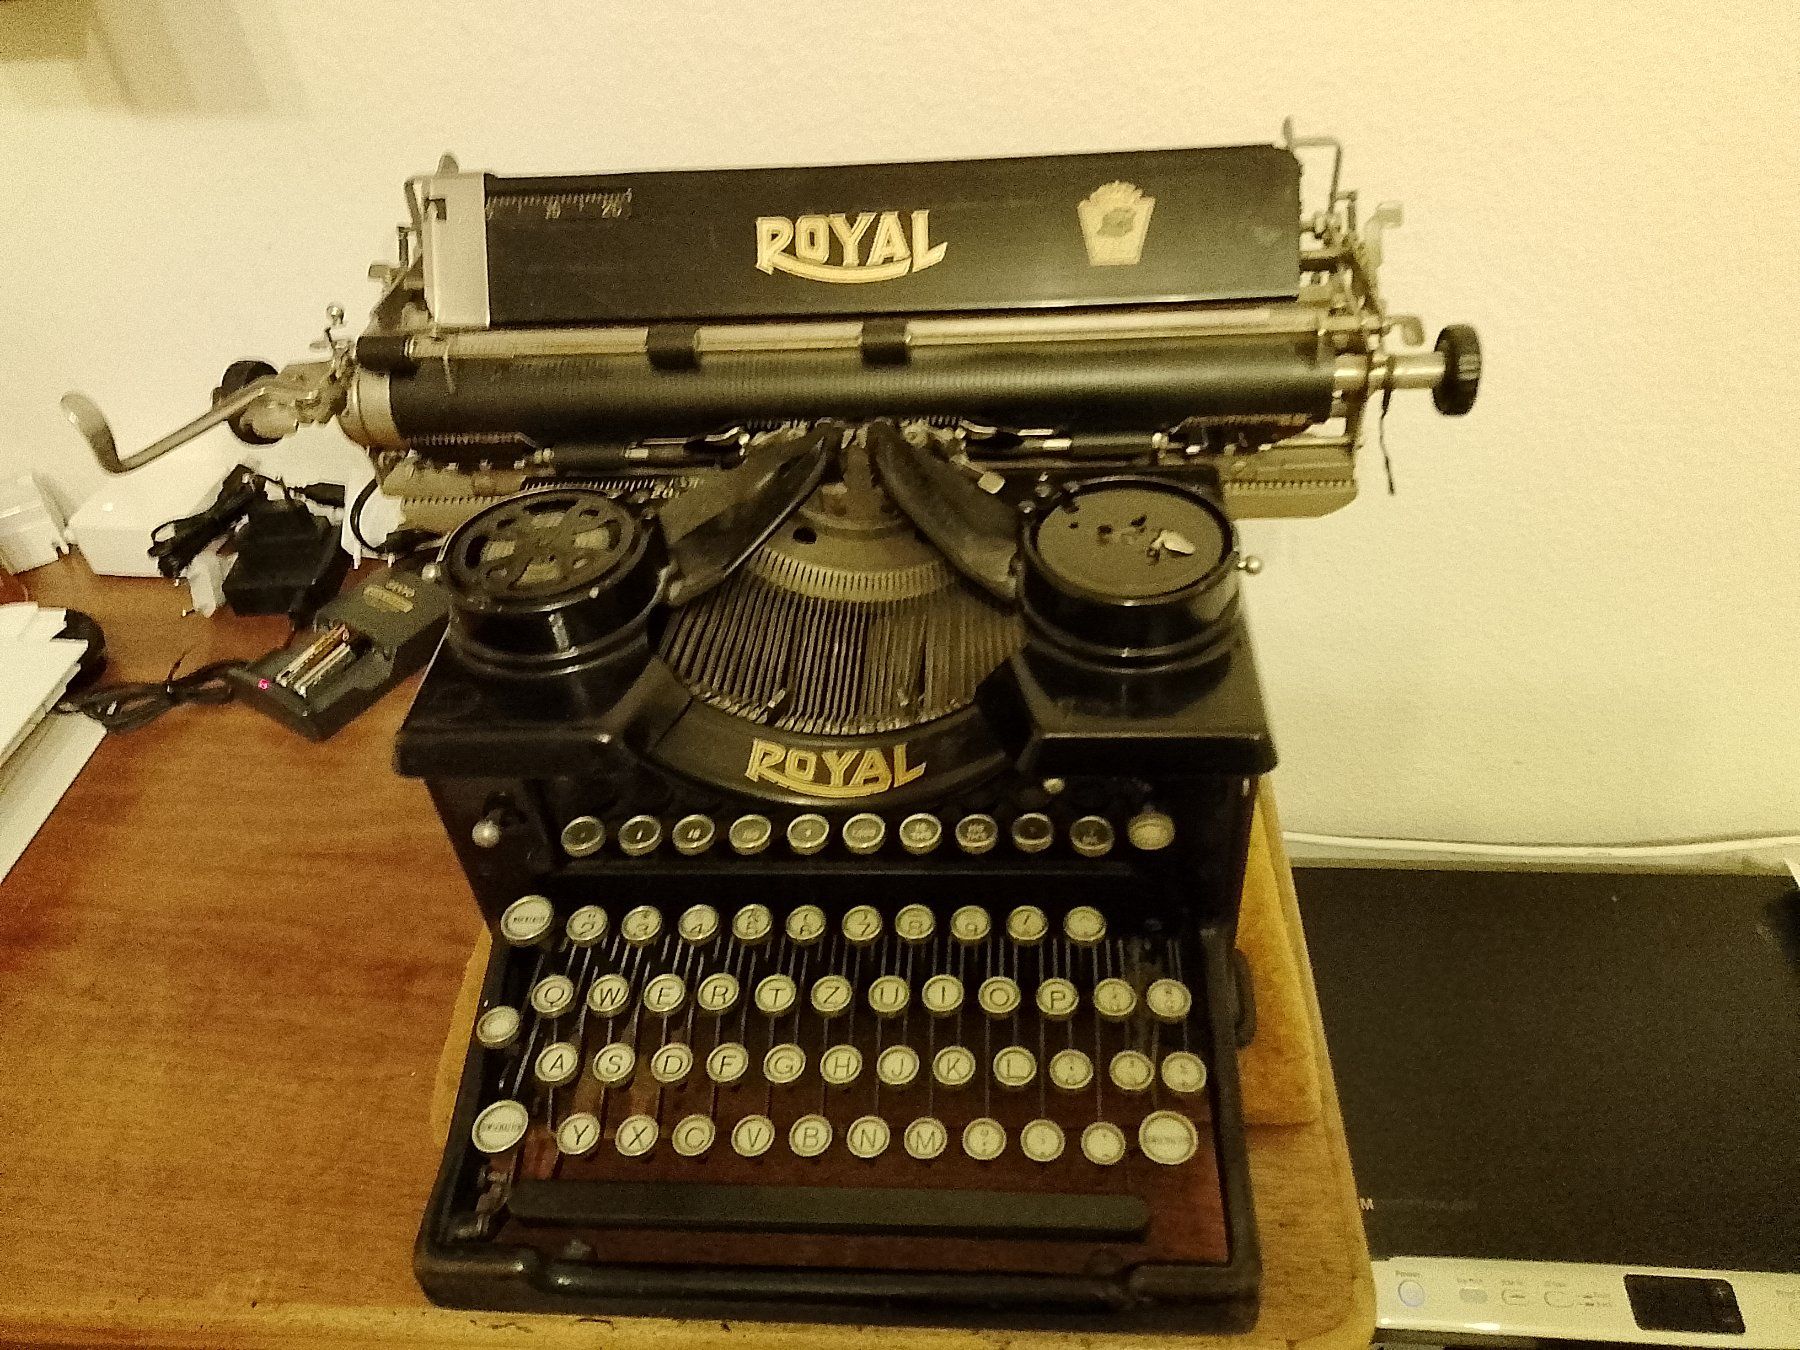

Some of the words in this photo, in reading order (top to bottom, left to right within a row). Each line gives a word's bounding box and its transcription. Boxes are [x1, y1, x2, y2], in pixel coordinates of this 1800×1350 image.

[755, 210, 948, 284] ROYAL
[745, 737, 927, 798] ROYAL
[544, 985, 566, 1005] Q
[598, 987, 622, 1005] W
[656, 986, 674, 1004] E
[711, 986, 728, 1004] R
[768, 988, 784, 1005] T
[822, 987, 841, 1004] Z
[880, 987, 898, 1005] U
[940, 986, 946, 1004] I
[989, 987, 1009, 1006] O
[1051, 991, 1066, 1007] P
[548, 1053, 565, 1073] A
[607, 1055, 623, 1075] S
[663, 1055, 683, 1074] D
[720, 1056, 738, 1074] F
[774, 1056, 795, 1074] G
[834, 1056, 853, 1075] H
[891, 1056, 905, 1076] J
[946, 1057, 963, 1076] K
[1006, 1059, 1023, 1078] L
[572, 1125, 591, 1145] Y
[629, 1126, 648, 1147] X
[684, 1127, 704, 1148] C
[747, 1127, 762, 1148] V
[803, 1127, 819, 1148] B
[860, 1129, 877, 1148] N
[915, 1130, 936, 1151] M
